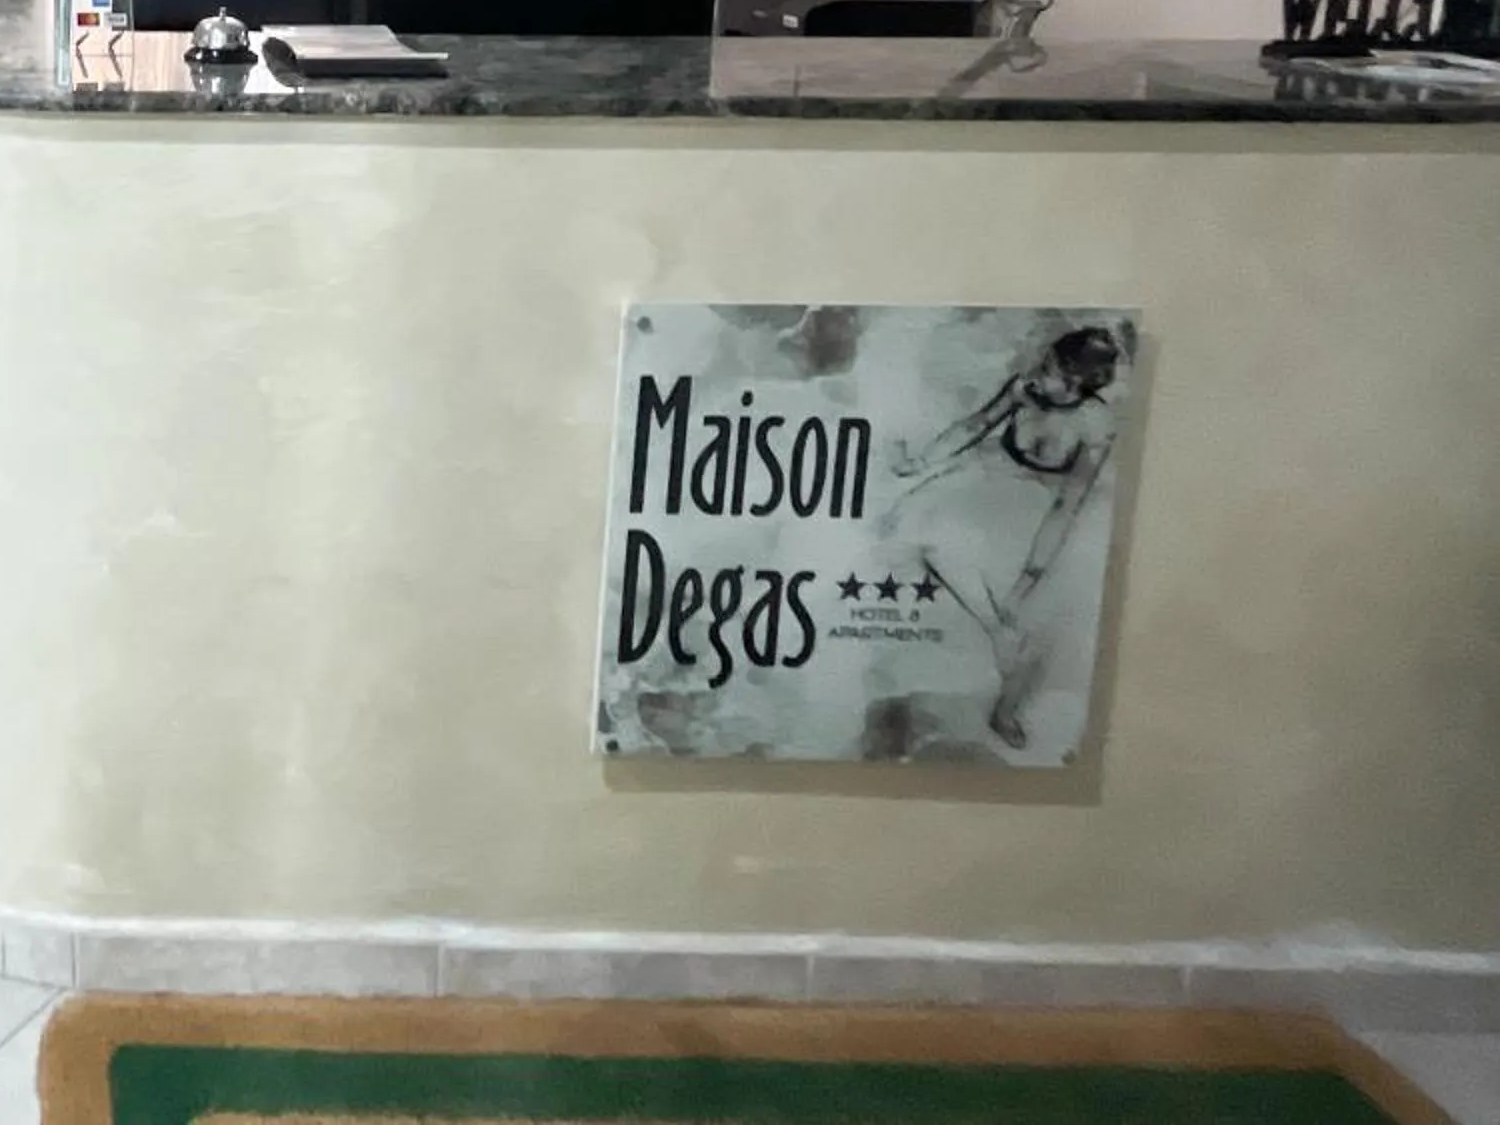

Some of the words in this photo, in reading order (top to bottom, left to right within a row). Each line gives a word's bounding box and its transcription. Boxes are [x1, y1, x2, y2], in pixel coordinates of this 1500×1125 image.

[629, 375, 871, 518] Maison
[617, 529, 817, 688] Degas
[850, 608, 902, 621] HOTEL
